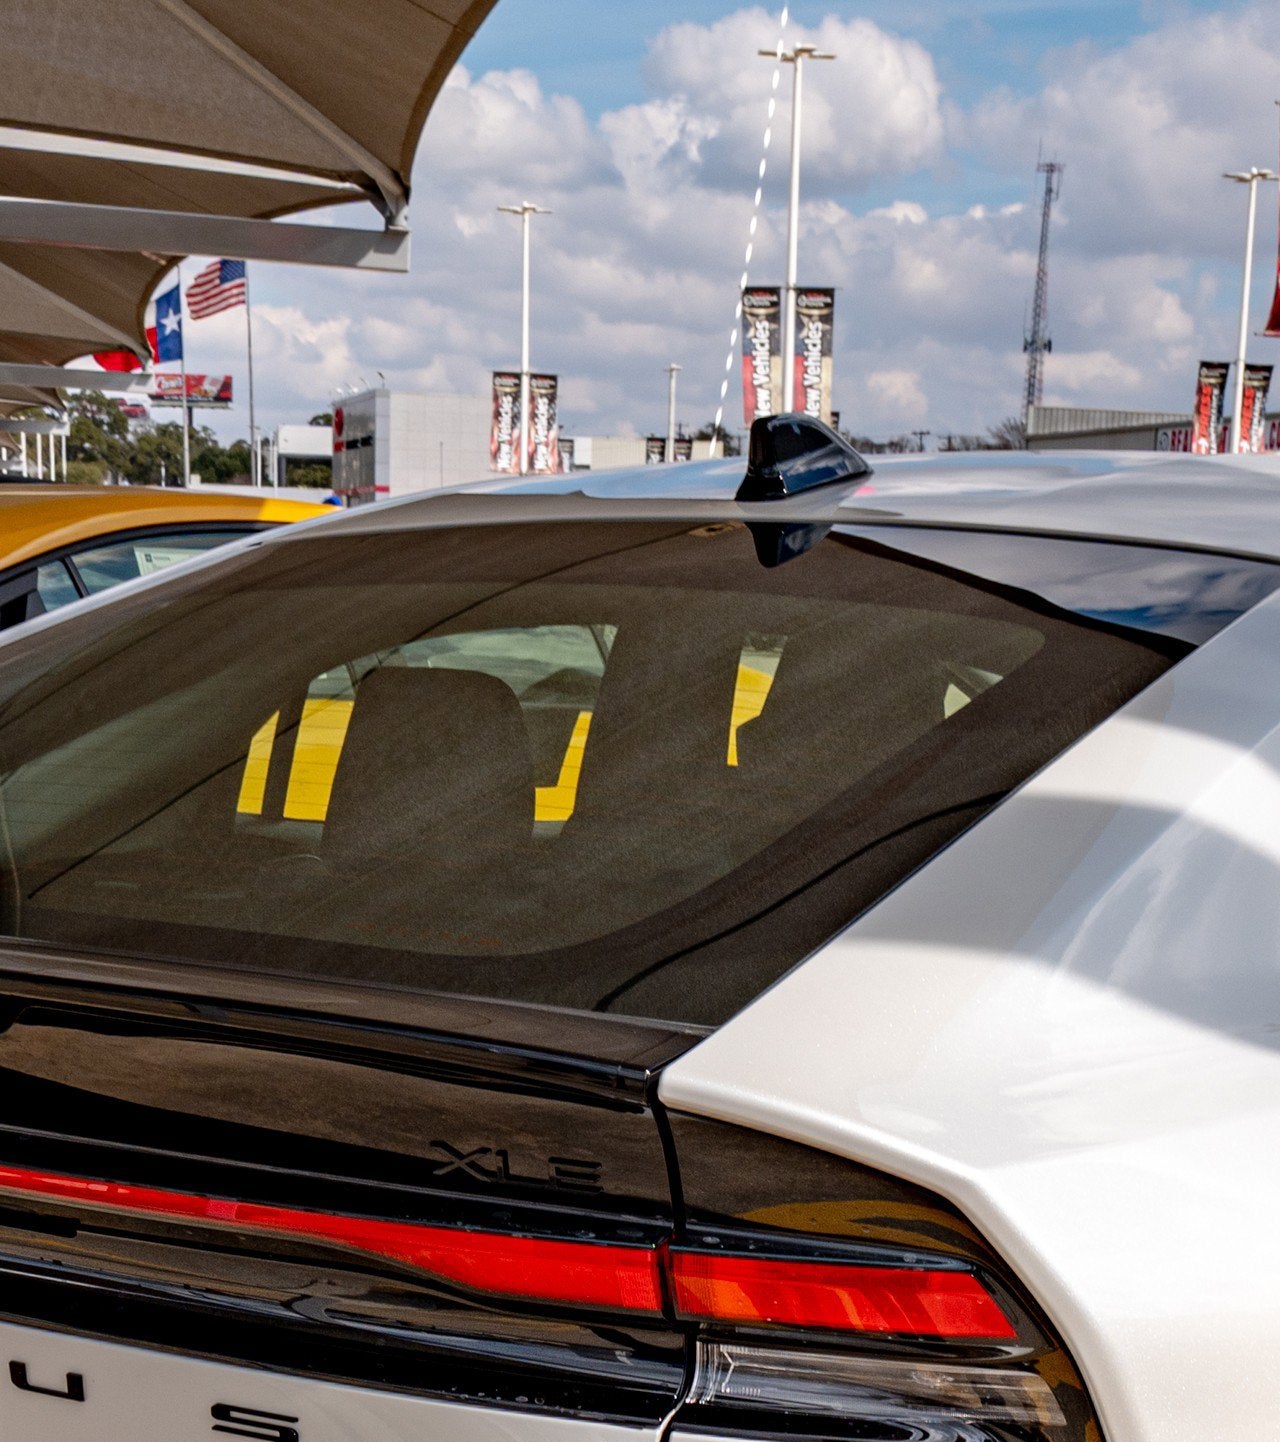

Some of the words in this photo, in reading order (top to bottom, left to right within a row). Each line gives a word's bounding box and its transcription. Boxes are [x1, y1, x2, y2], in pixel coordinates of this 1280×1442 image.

[751, 320, 770, 386] Vehicles
[802, 321, 822, 386] Vehicles
[498, 394, 513, 442] Vehicles
[534, 397, 549, 443] Vehicles
[497, 442, 511, 469] New
[534, 444, 548, 470] New
[430, 1139, 605, 1195] XLE
